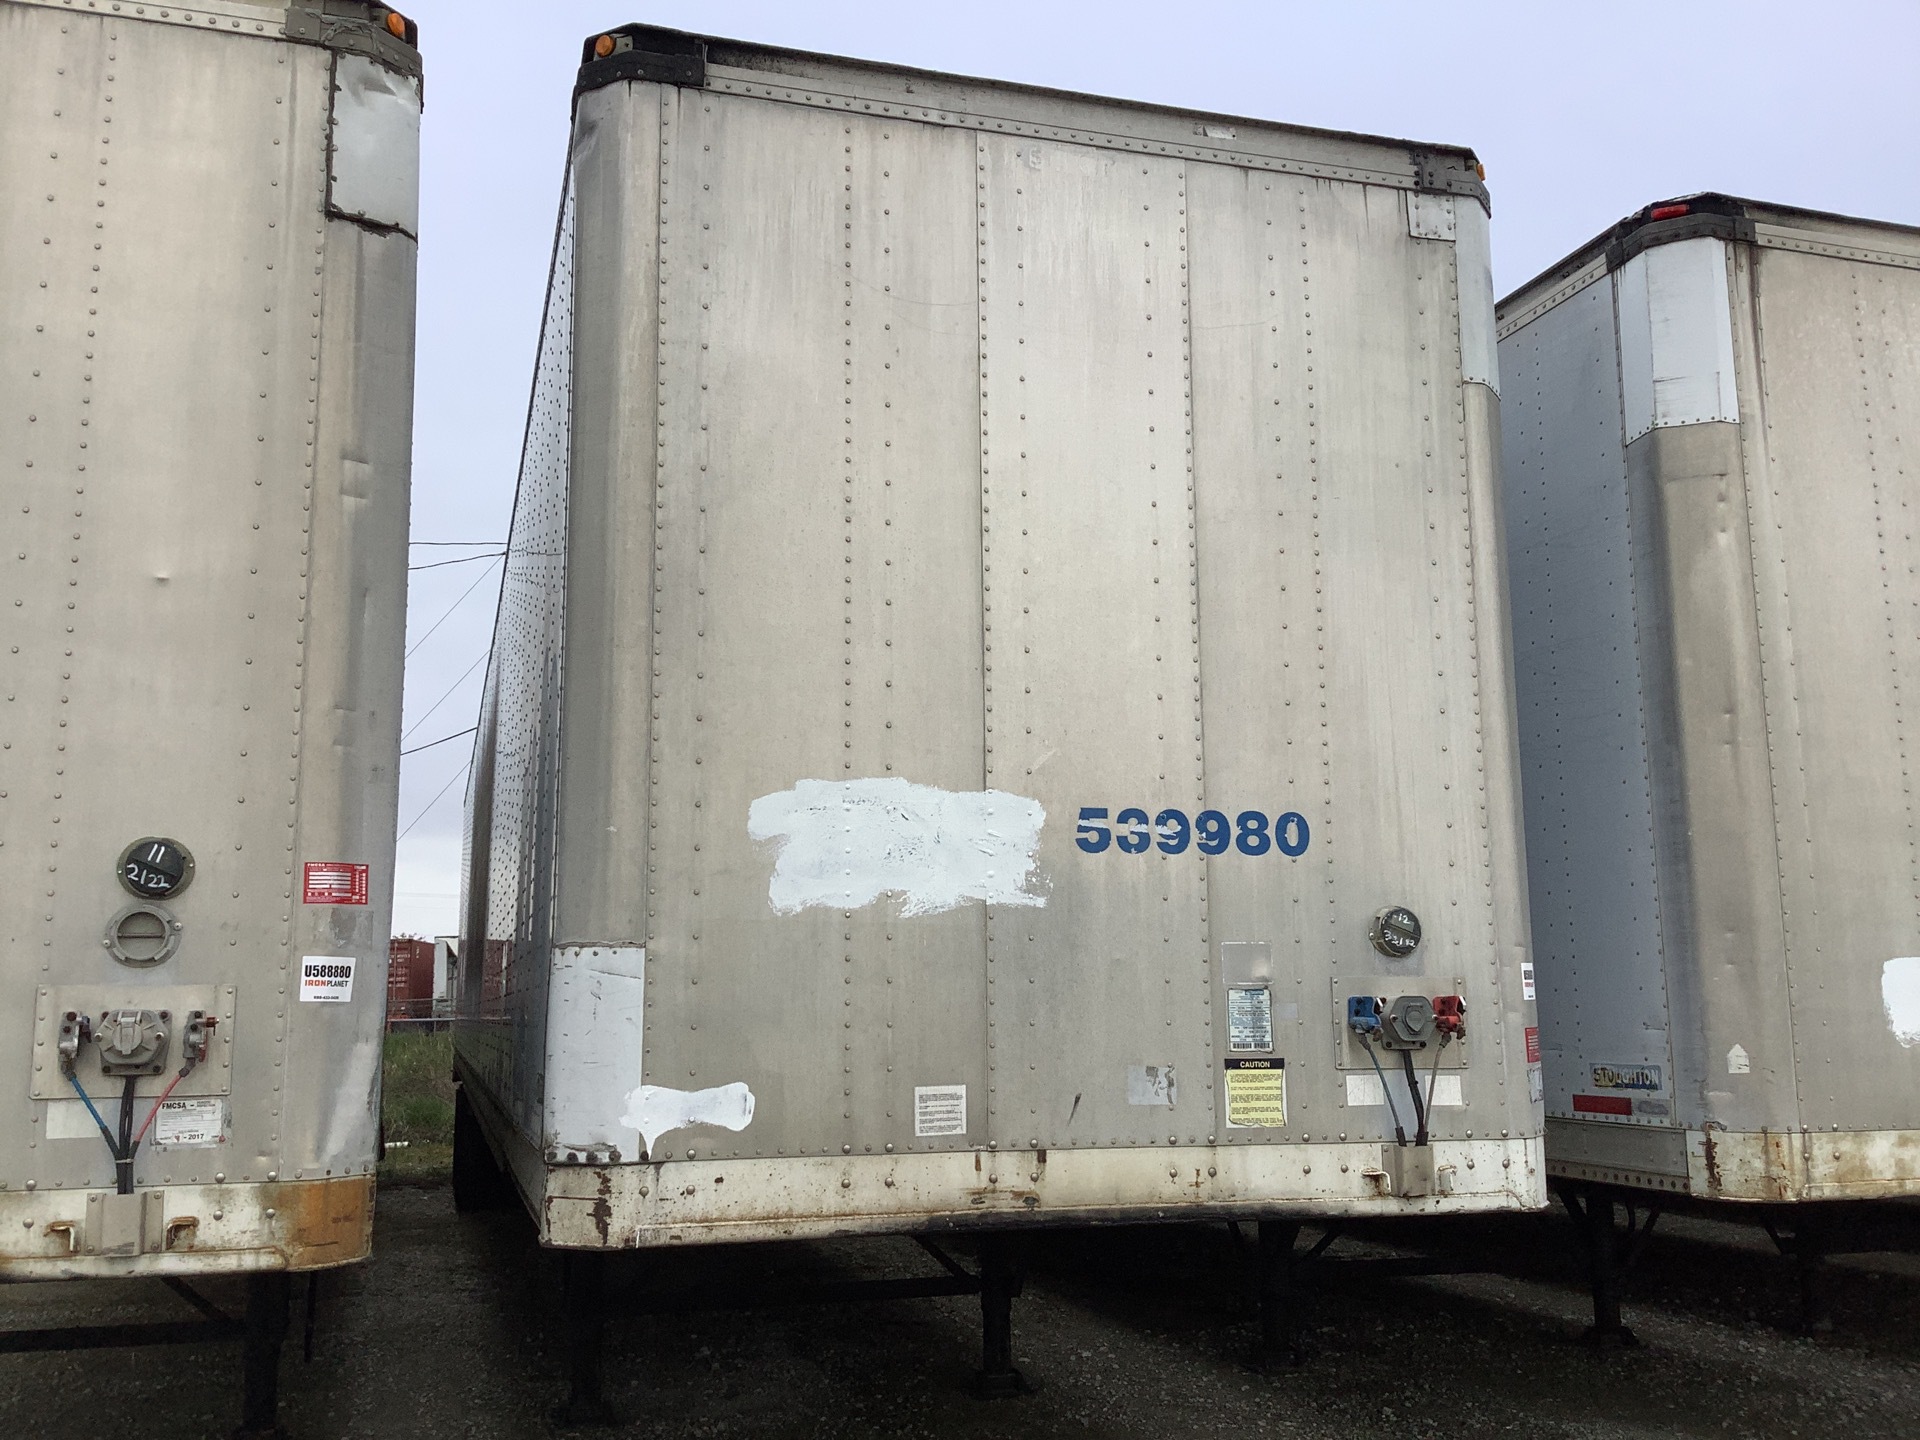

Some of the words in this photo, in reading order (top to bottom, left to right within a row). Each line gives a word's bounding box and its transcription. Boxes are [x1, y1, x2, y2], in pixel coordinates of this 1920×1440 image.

[1075, 807, 1311, 857] 539980
[304, 964, 352, 979] U588880
[1593, 1066, 1660, 1086] STOUGHTON
[161, 1102, 187, 1110] FMCSA
